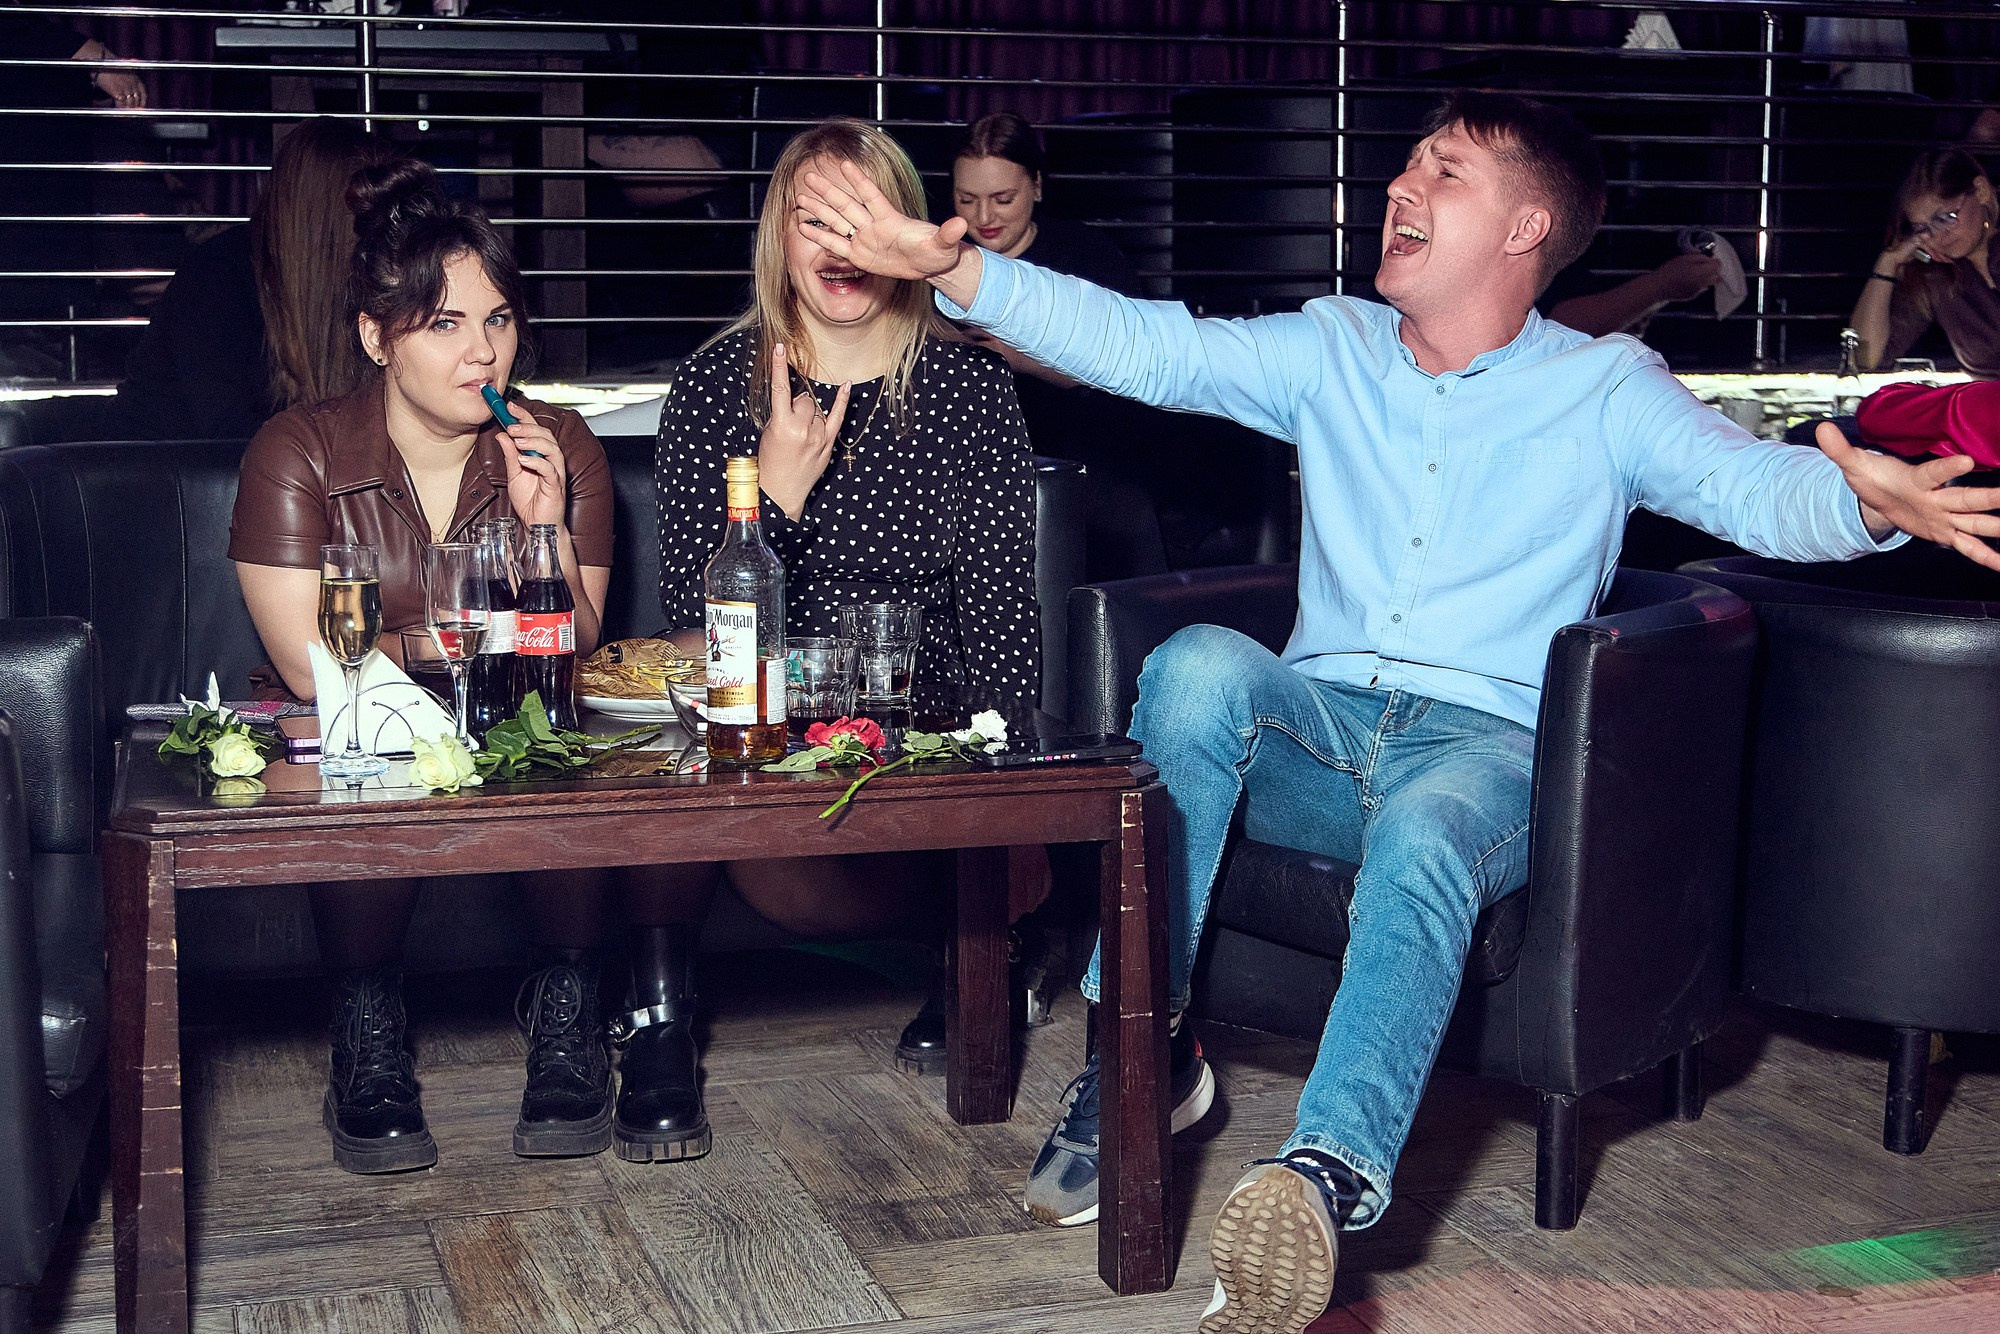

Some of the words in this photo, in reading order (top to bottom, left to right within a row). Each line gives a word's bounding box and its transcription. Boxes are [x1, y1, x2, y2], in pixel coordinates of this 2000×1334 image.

[713, 608, 753, 630] Morgan
[515, 626, 558, 648] ca-Cola
[719, 675, 744, 688] Gold
